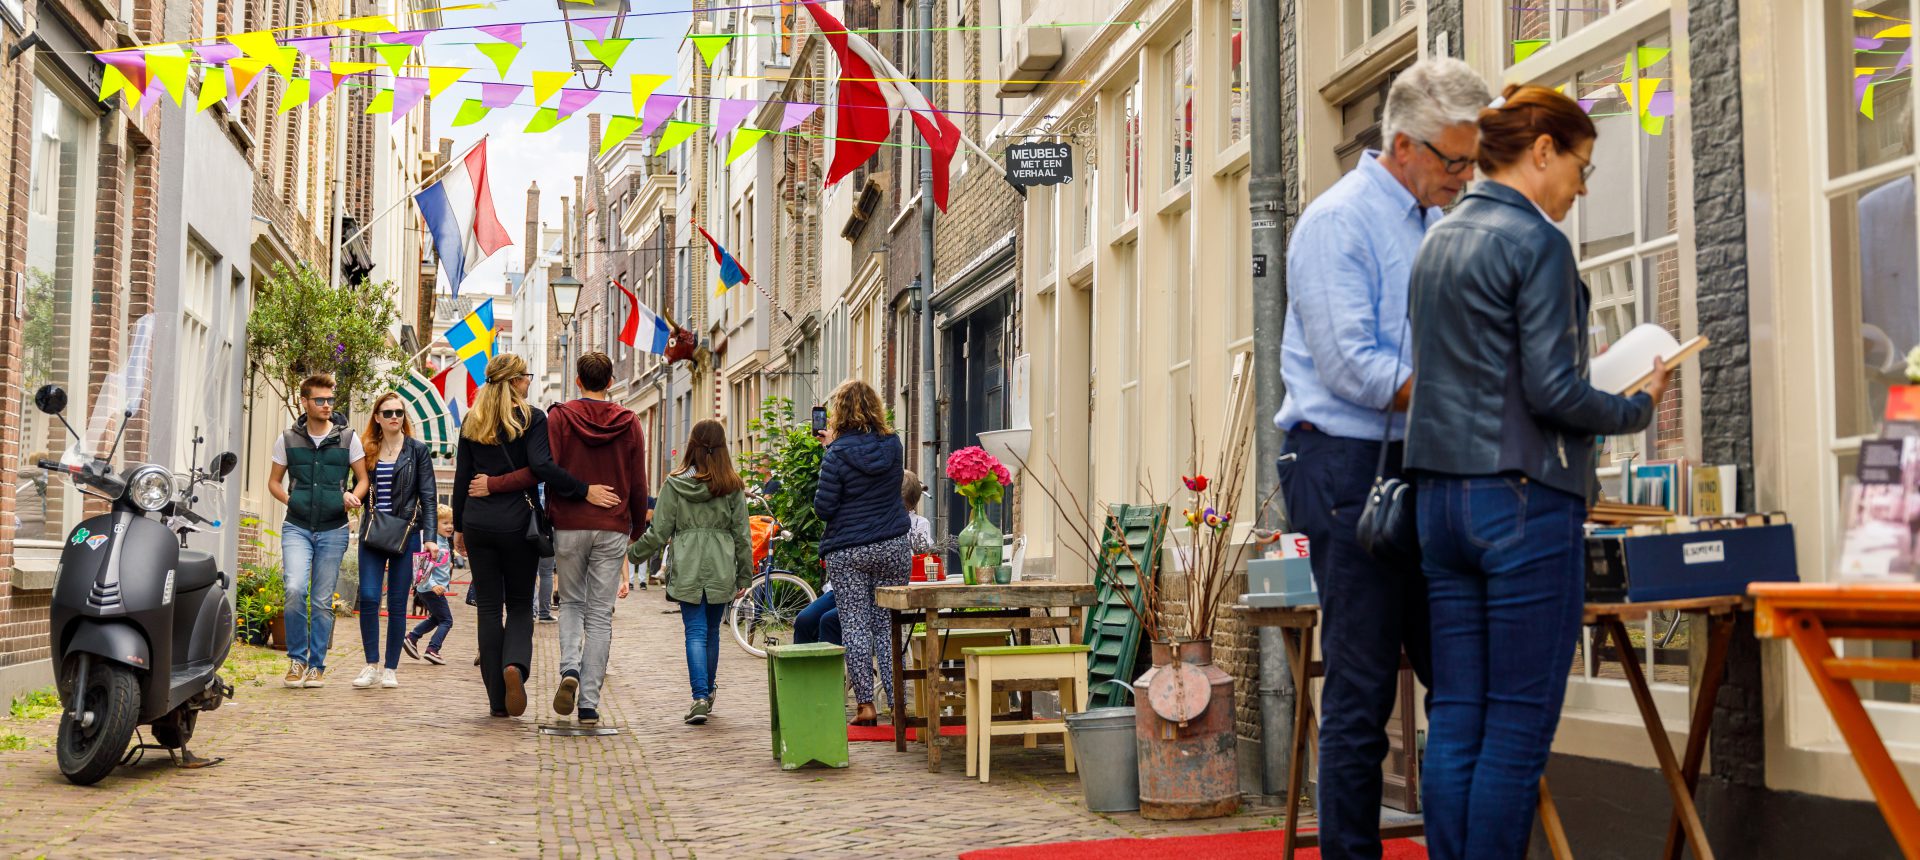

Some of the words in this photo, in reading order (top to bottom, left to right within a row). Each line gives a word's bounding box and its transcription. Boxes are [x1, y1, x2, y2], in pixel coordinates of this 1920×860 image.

[1011, 148, 1068, 160] MEUBELS
[1020, 160, 1041, 169] MET
[1043, 160, 1062, 168] EEN
[1012, 169, 1057, 178] VERHAAL
[1063, 175, 1073, 184] 17
